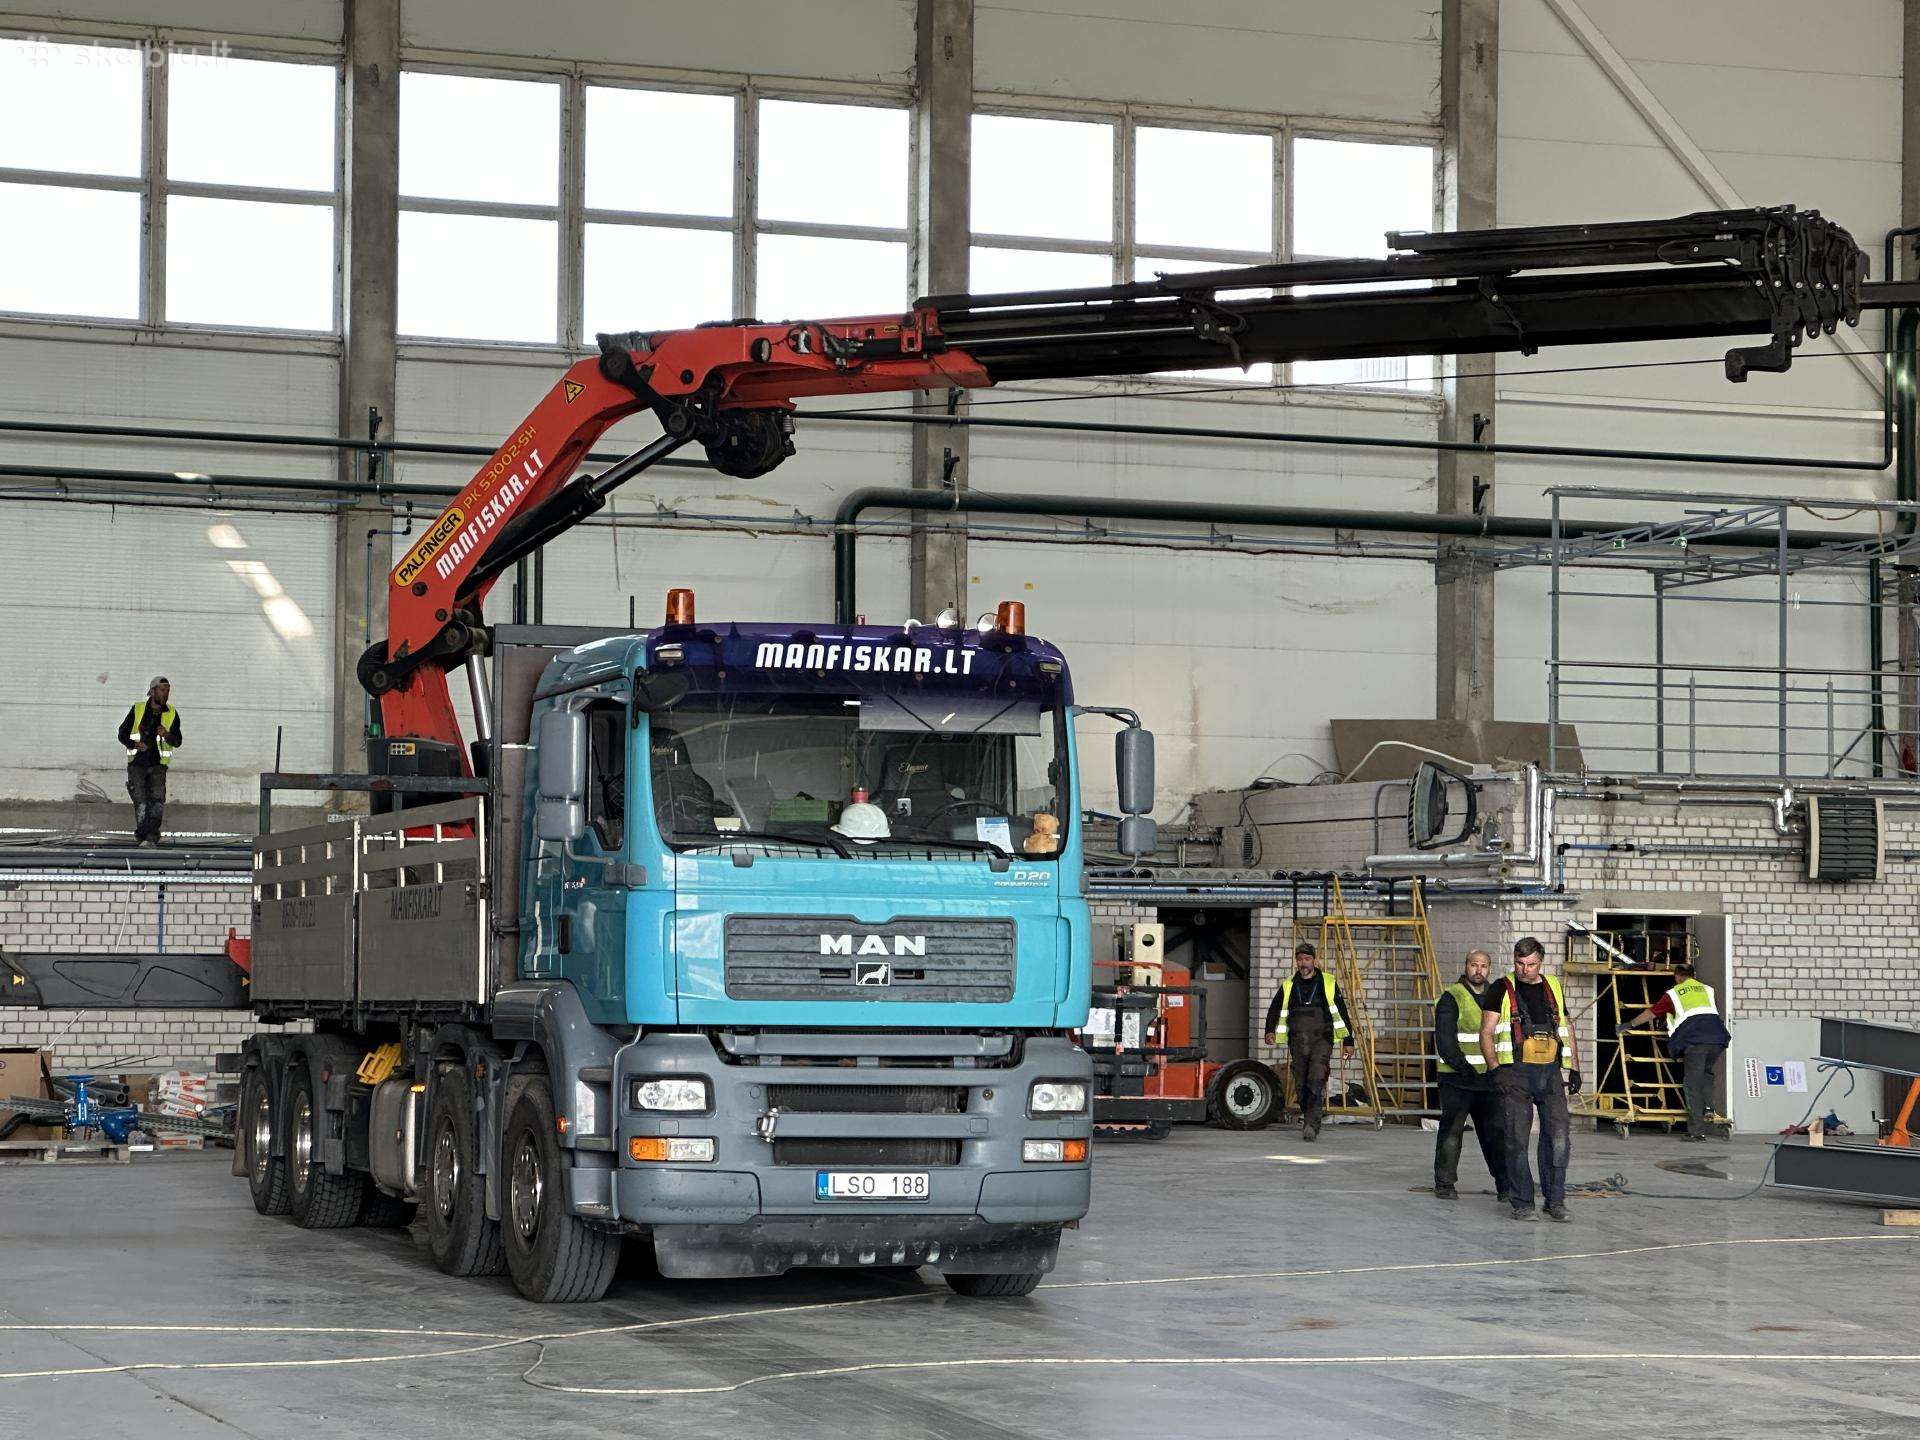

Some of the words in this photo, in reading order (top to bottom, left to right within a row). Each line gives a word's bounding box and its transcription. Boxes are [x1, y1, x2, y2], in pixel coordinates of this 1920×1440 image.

[398, 511, 462, 583] PALFINGER
[463, 489, 482, 509] PK
[481, 425, 537, 492] 53002-SH
[435, 448, 544, 580] MANFISKAR.LT
[755, 643, 976, 675] MANFISKAR.LT
[820, 934, 926, 956] MAN
[832, 1176, 875, 1194] LSO
[892, 1176, 925, 1194] 188
